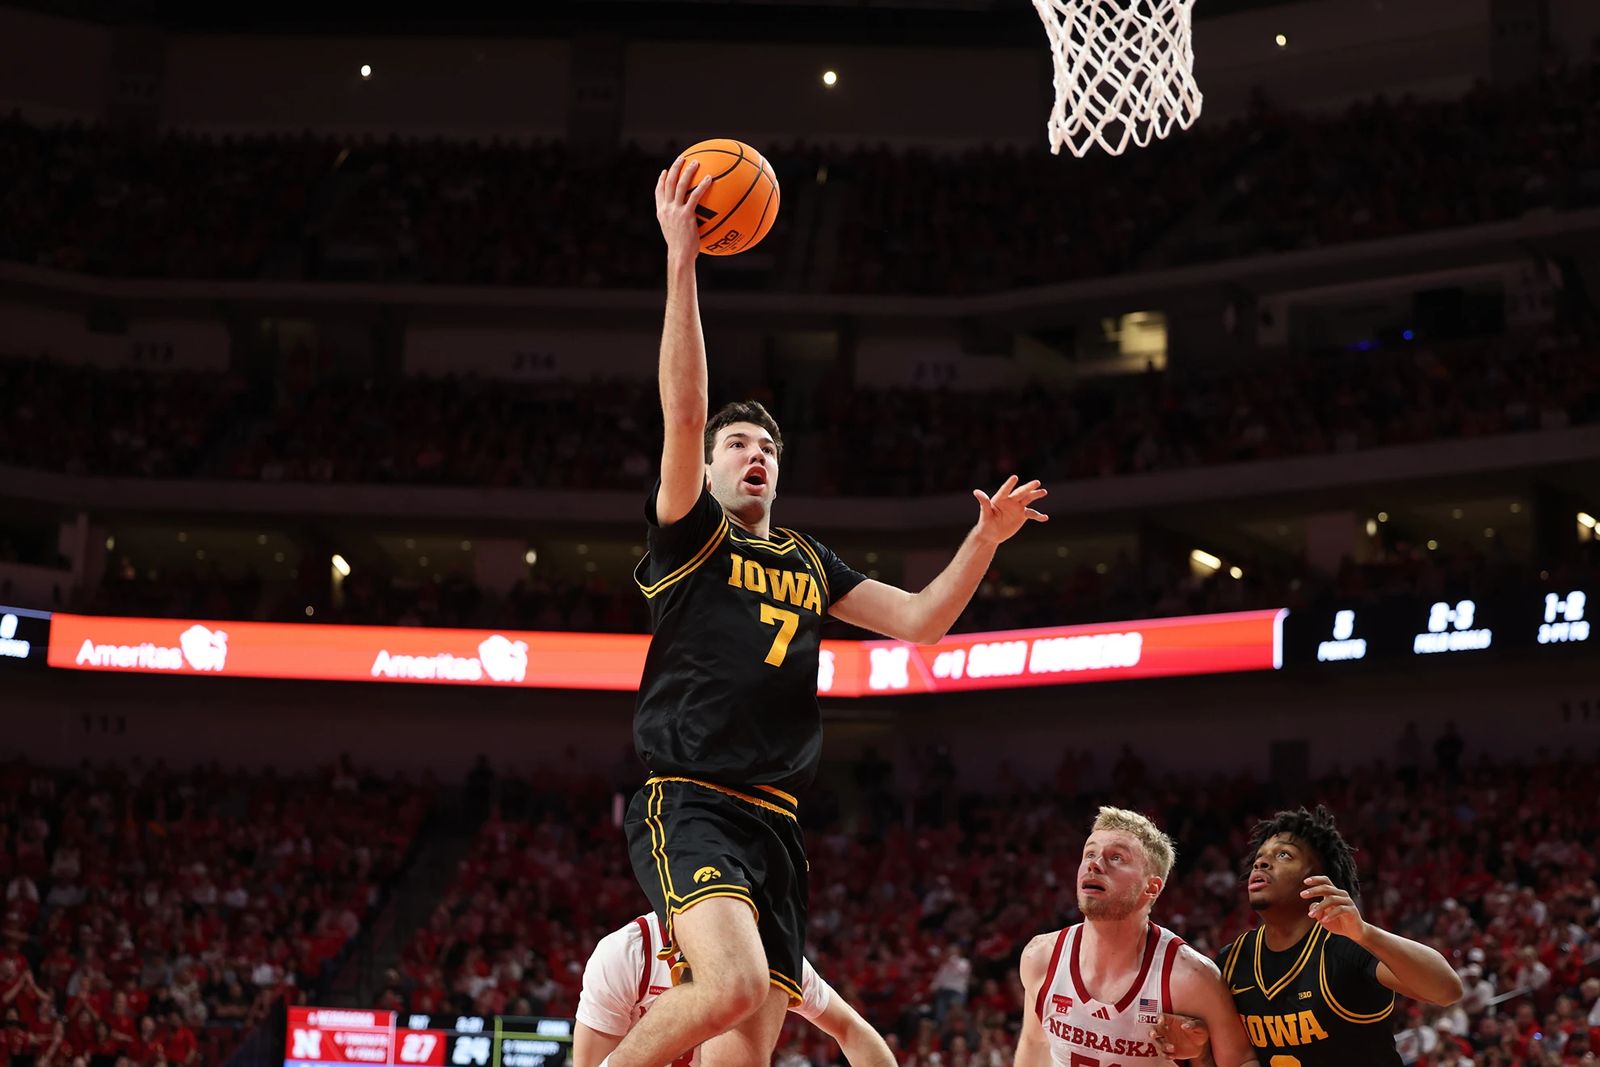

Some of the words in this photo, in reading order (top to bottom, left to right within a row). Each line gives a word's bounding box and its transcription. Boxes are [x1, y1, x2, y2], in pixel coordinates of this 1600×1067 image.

[705, 230, 740, 252] PRO
[727, 552, 822, 616] IOWA
[759, 602, 800, 668] 7
[76, 639, 183, 670] Ameritas
[292, 1028, 321, 1059] N
[1049, 1017, 1159, 1057] NEBRASKA
